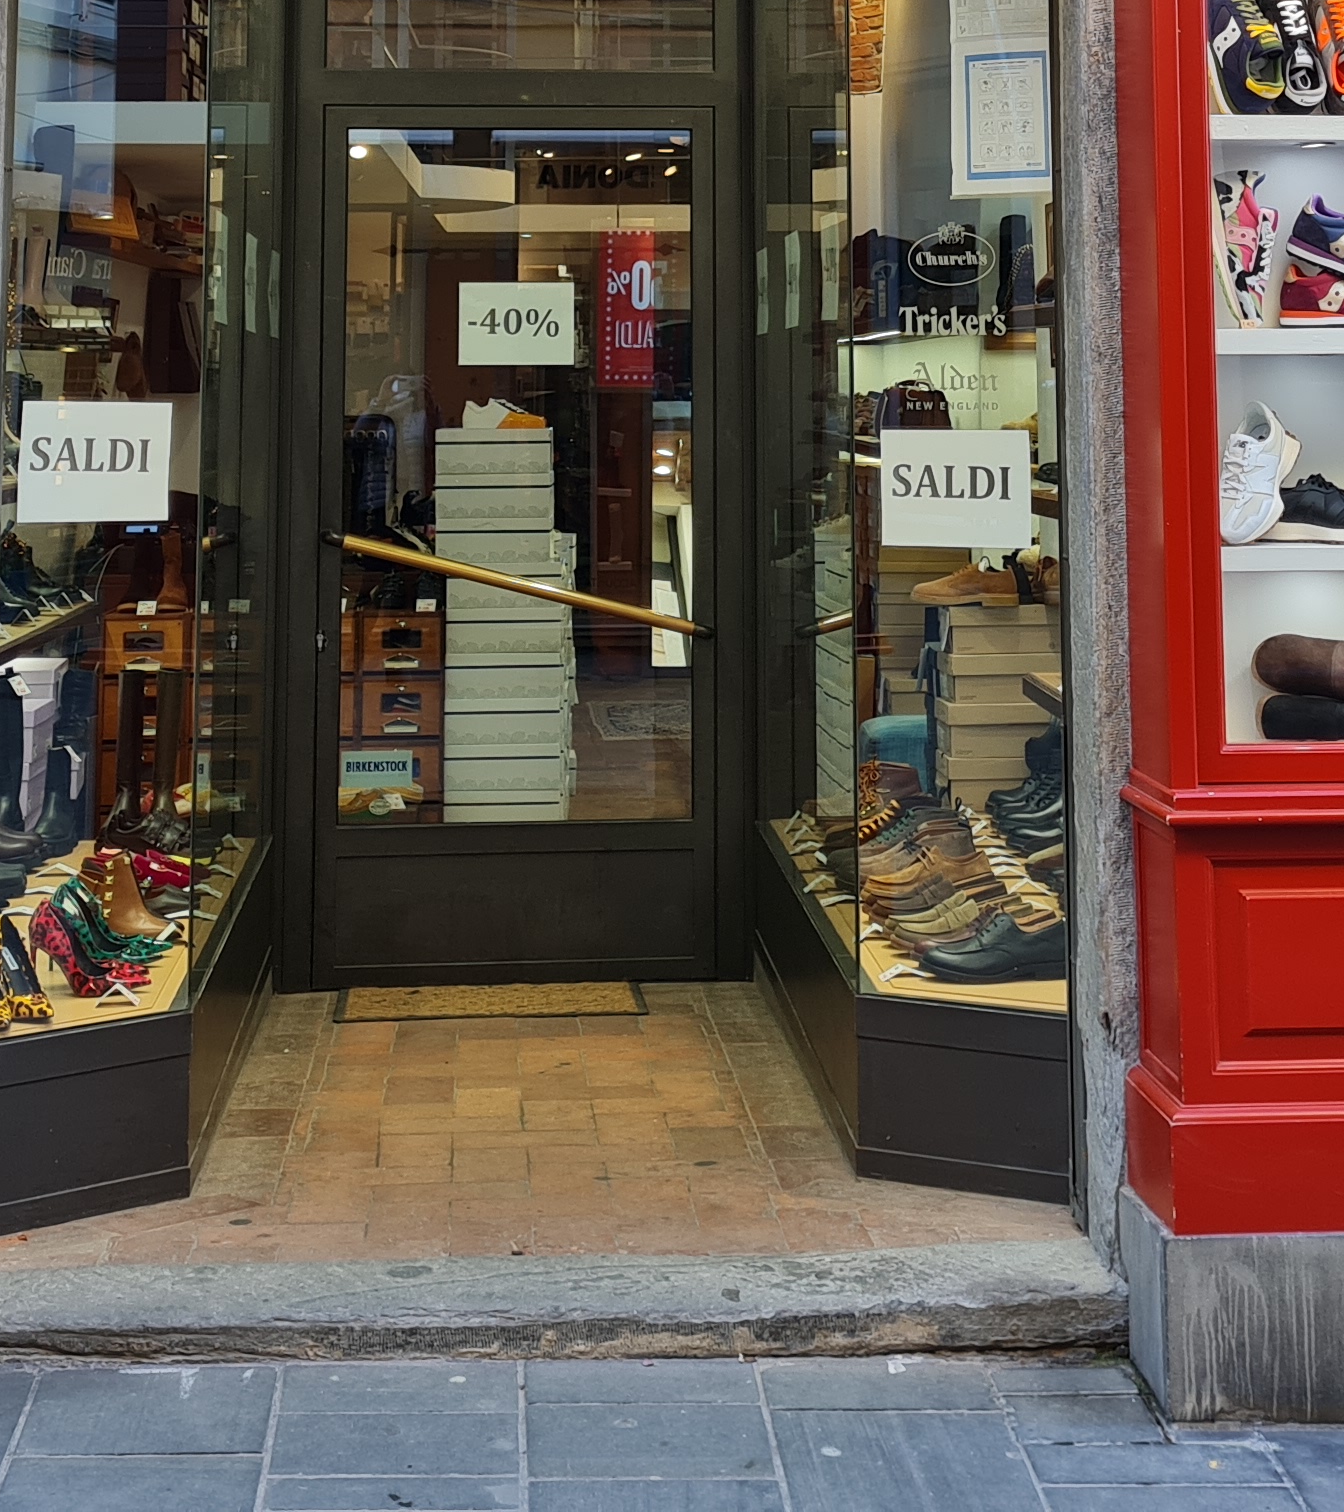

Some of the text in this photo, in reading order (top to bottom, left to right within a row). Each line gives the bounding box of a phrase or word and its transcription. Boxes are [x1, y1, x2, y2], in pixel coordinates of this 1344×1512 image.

[915, 250, 988, 267] Church's
[467, 307, 560, 338] -40%
[898, 304, 1007, 337] Tricker's
[906, 361, 999, 400] Alden
[906, 400, 999, 412] NEW ENGLAND
[29, 437, 151, 473] SALDI
[891, 464, 1012, 501] SALDI
[345, 760, 408, 773] BIRKENSTOCK
